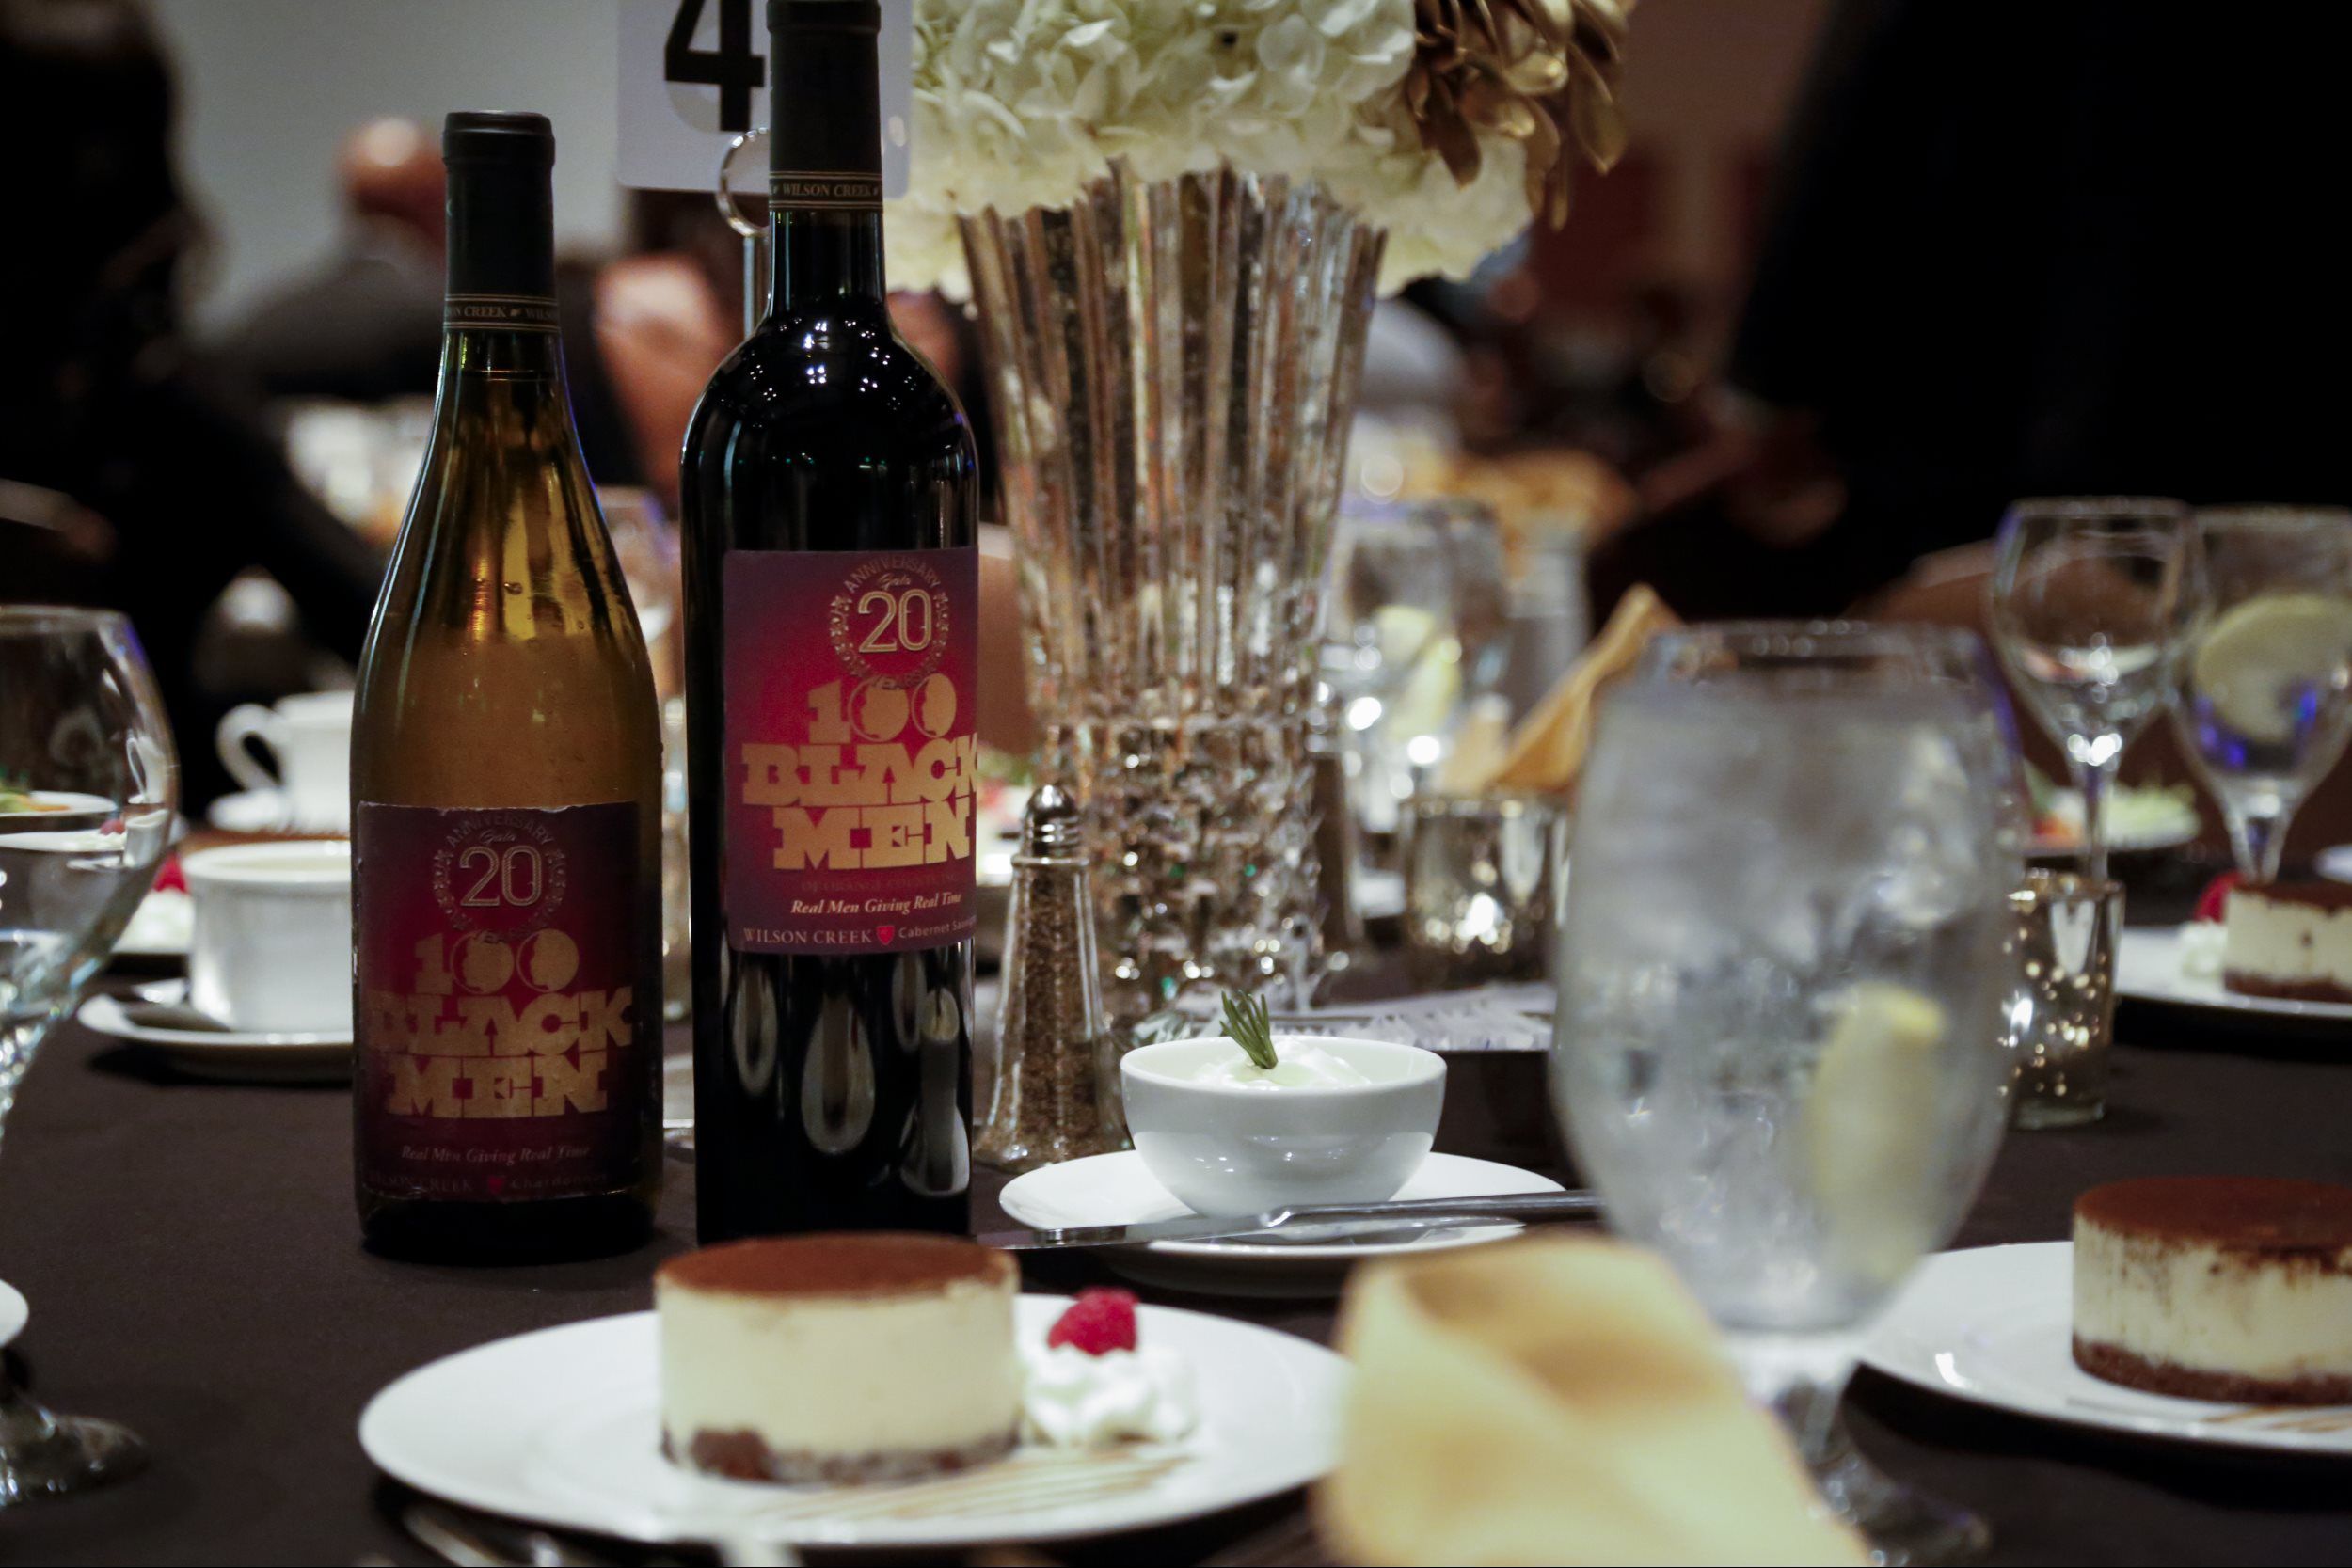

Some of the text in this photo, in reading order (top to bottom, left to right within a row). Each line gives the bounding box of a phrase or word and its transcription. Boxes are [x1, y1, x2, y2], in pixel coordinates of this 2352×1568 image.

[664, 0, 766, 132] 4
[783, 182, 871, 198] WILSON CREEK
[464, 305, 507, 318] CREEK
[843, 554, 942, 594] ANNIVERSARY
[858, 588, 932, 653] 20
[808, 673, 958, 744] 100
[445, 811, 555, 848] ANNIVERSARY
[772, 796, 971, 870] MEN
[458, 846, 542, 907] 20
[790, 891, 962, 916] Real Men Giving Real Time
[413, 927, 580, 996] 100
[743, 927, 807, 944] WILSON
[813, 929, 873, 945] CREEK
[898, 922, 950, 939] Cabernet
[370, 985, 633, 1056] BLACK
[387, 1051, 608, 1118] MEN
[401, 1144, 591, 1167] Real Men Giving Real Time
